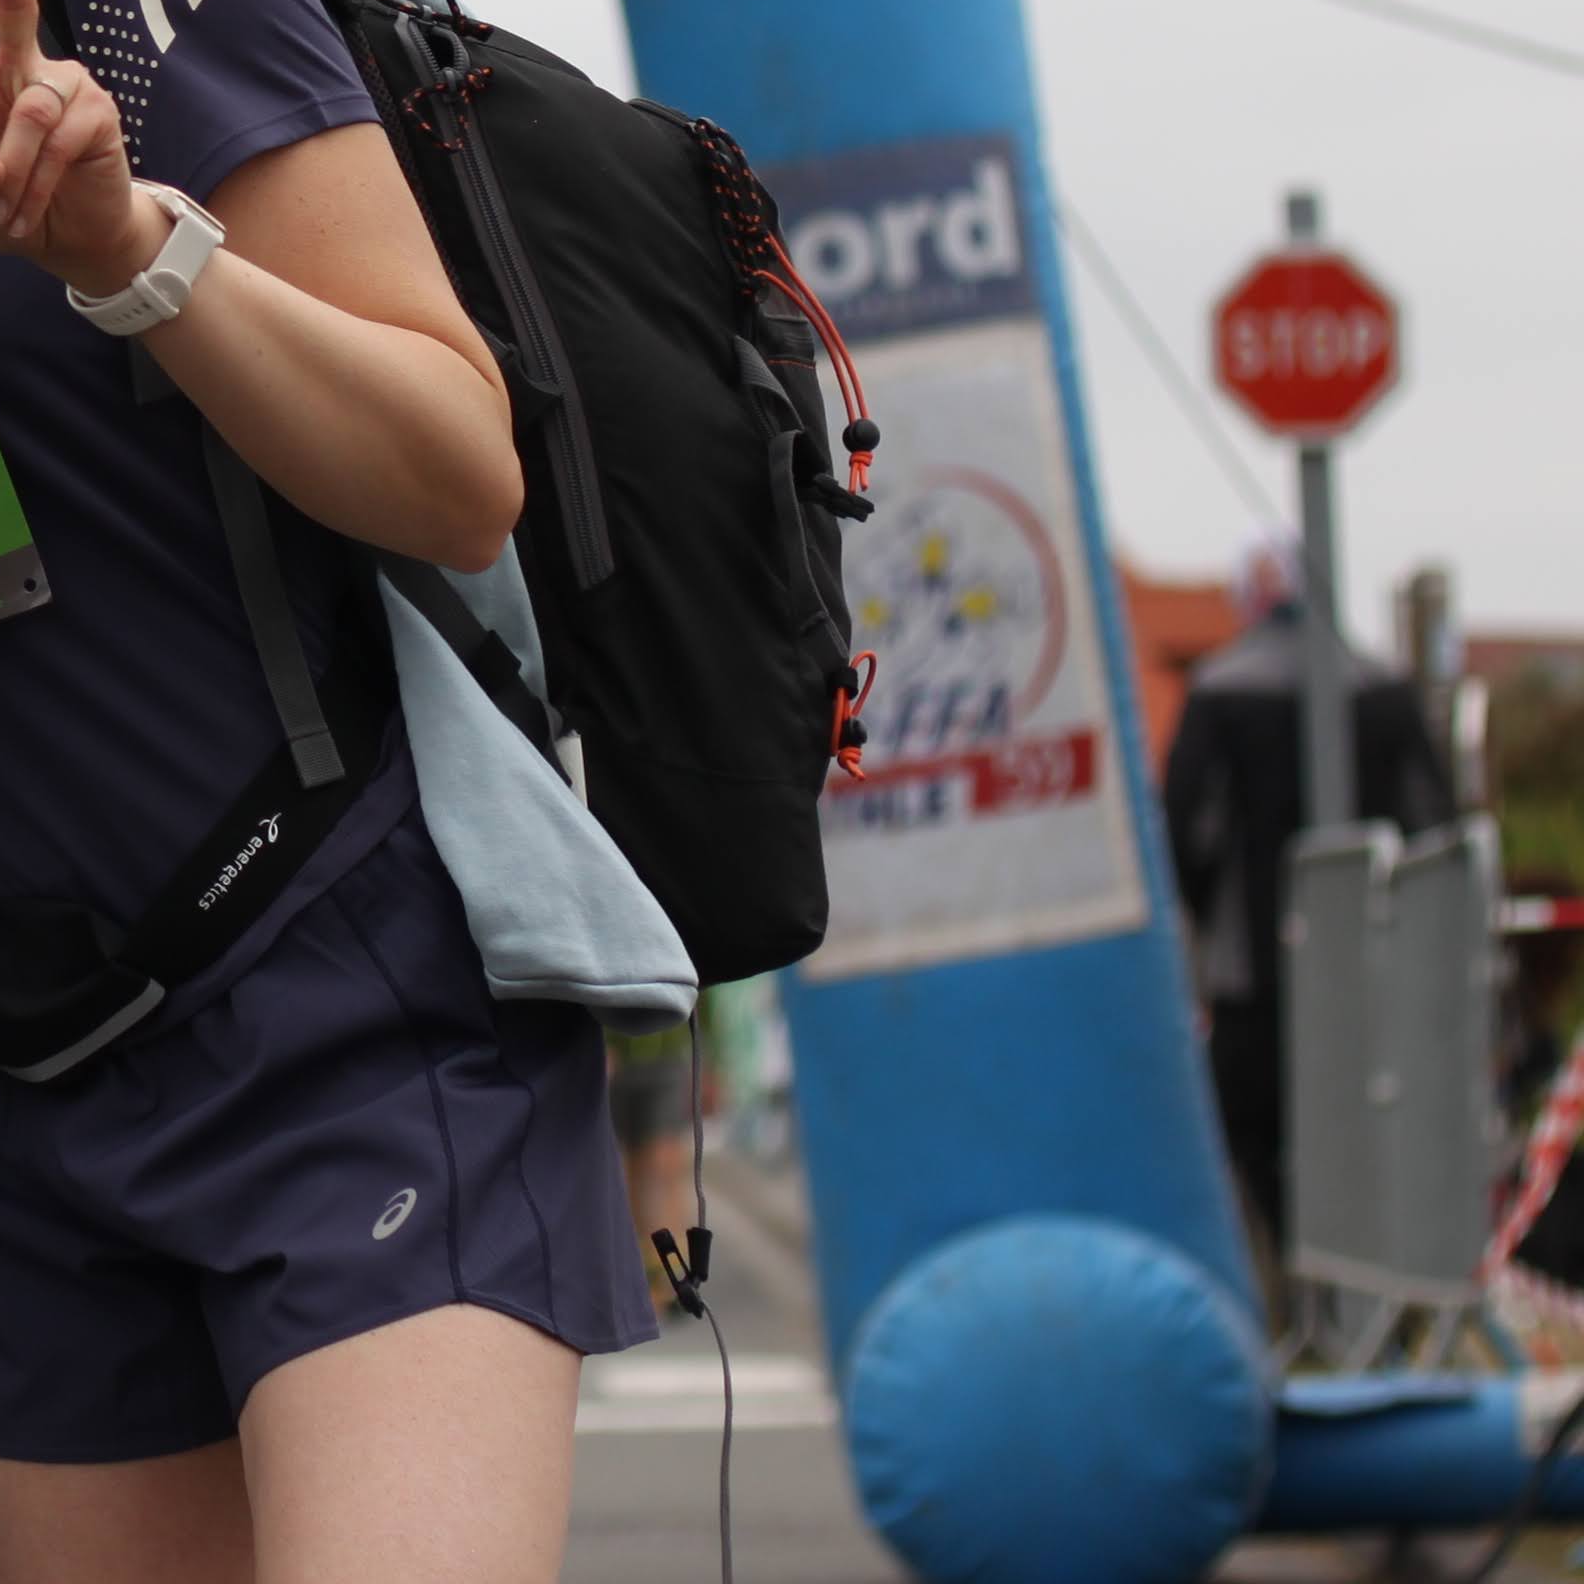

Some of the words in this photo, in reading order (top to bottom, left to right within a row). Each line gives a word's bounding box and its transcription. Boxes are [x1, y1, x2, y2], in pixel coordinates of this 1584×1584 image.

[792, 157, 1021, 298] ord
[1230, 311, 1390, 378] STOP
[198, 835, 264, 911] energetics
